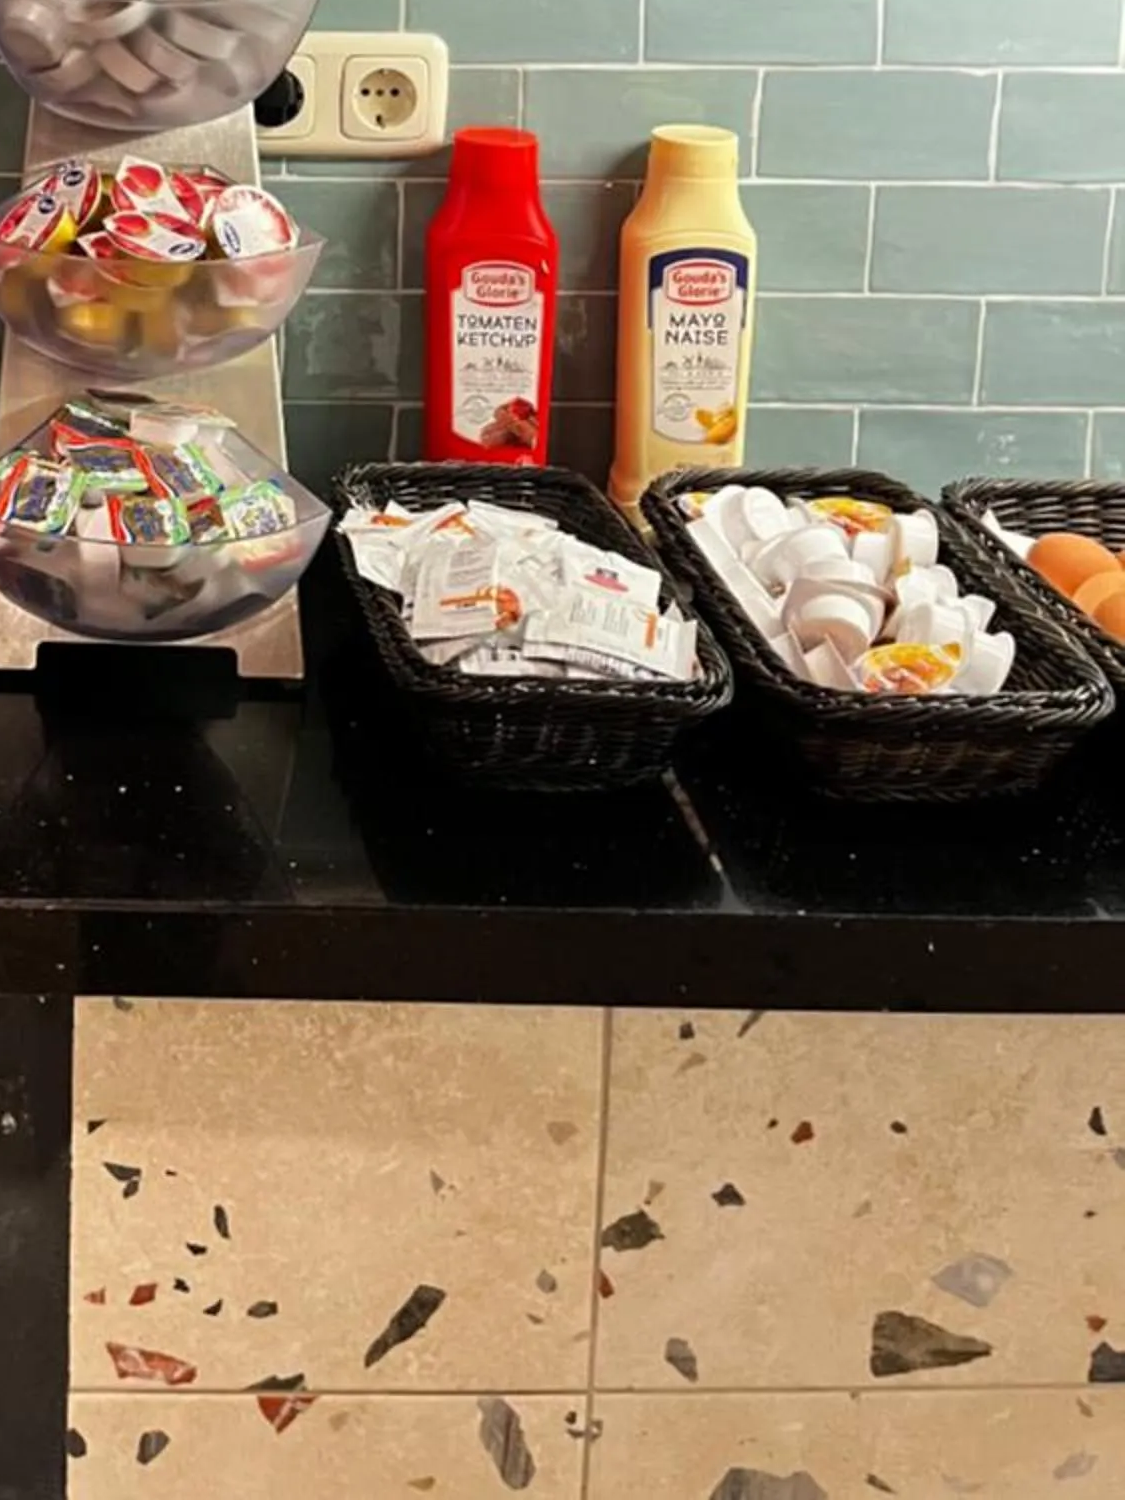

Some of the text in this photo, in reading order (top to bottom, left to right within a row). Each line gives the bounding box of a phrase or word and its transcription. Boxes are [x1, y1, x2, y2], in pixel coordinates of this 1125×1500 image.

[471, 272, 526, 285] Gouda's
[672, 270, 727, 284] Gouda's
[476, 285, 519, 299] Glorie
[678, 284, 720, 297] Glorie
[457, 313, 538, 331] TOMATEN
[669, 313, 726, 327] MAYO
[457, 331, 537, 349] KETCHUP
[664, 329, 729, 346] NAISE
